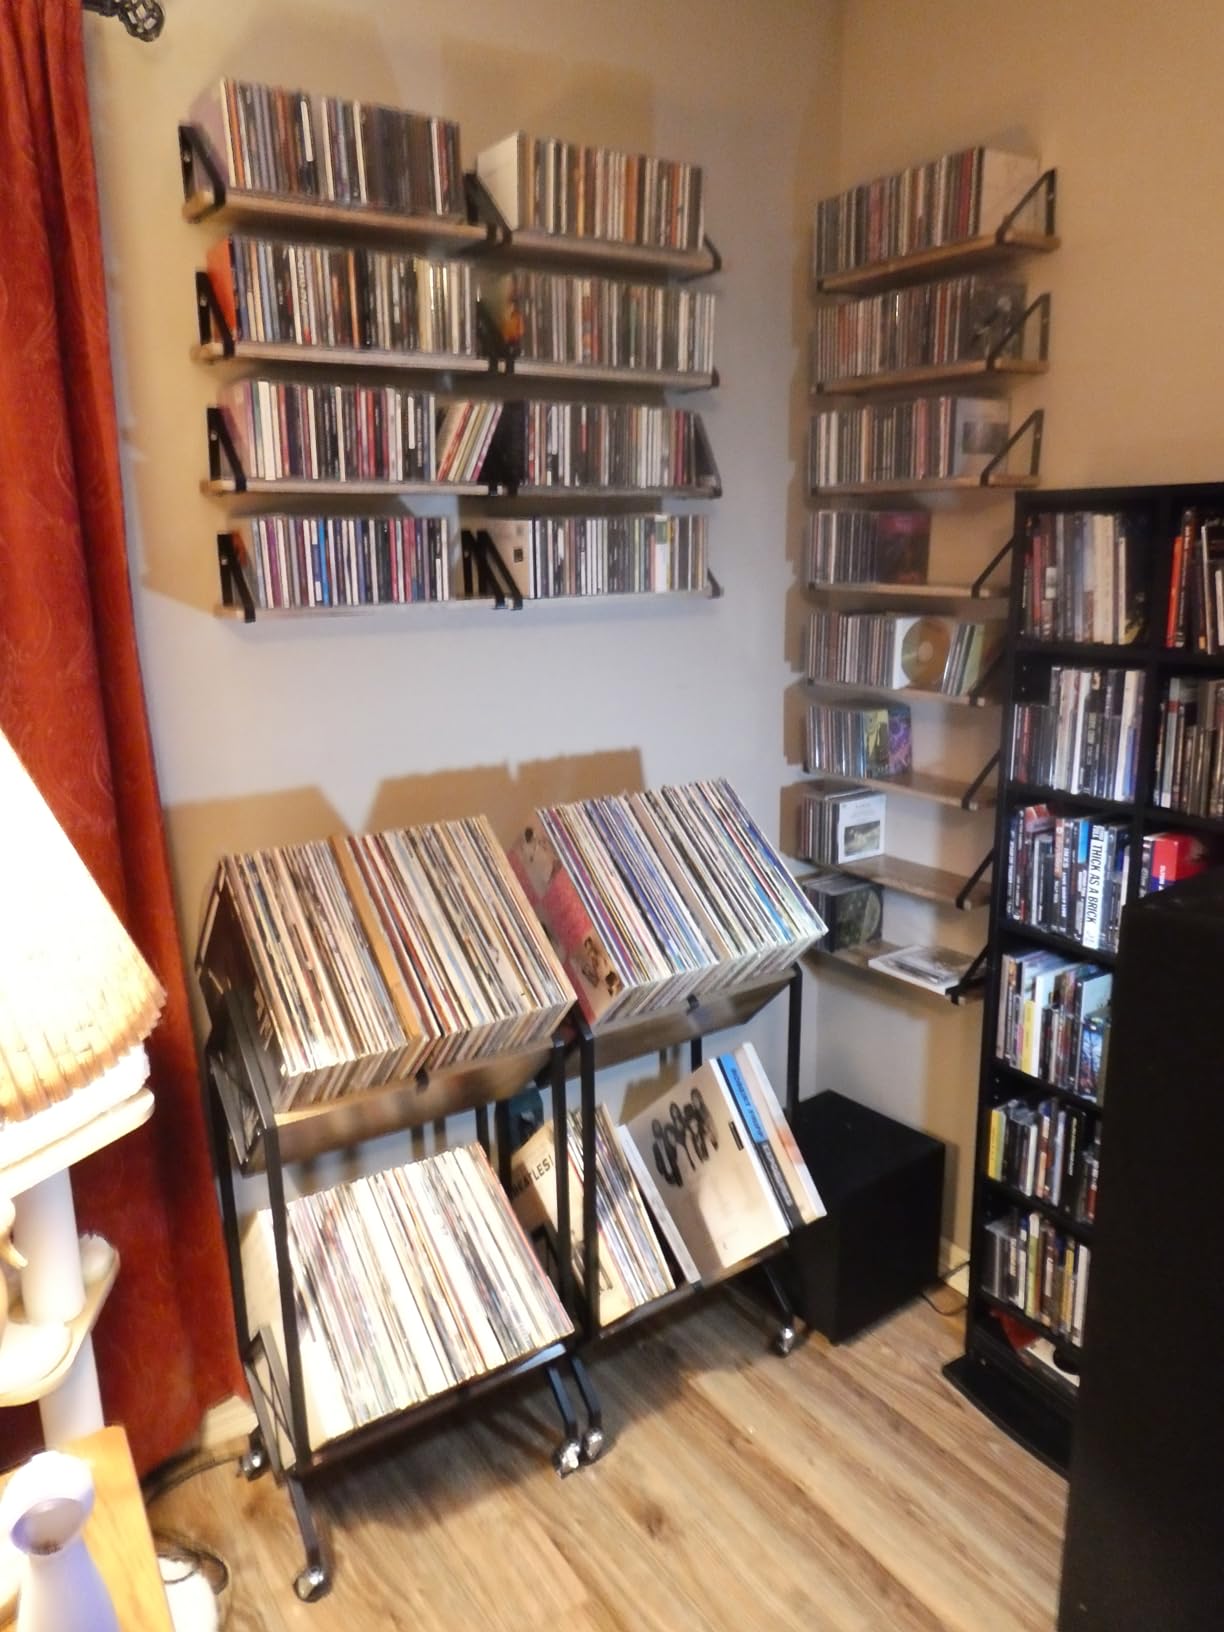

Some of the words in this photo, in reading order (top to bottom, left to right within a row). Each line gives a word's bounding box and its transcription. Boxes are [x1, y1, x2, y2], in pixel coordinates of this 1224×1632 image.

[1090, 844, 1103, 870] THICK
[1089, 873, 1100, 886] AS
[1086, 896, 1098, 924] BRICK
